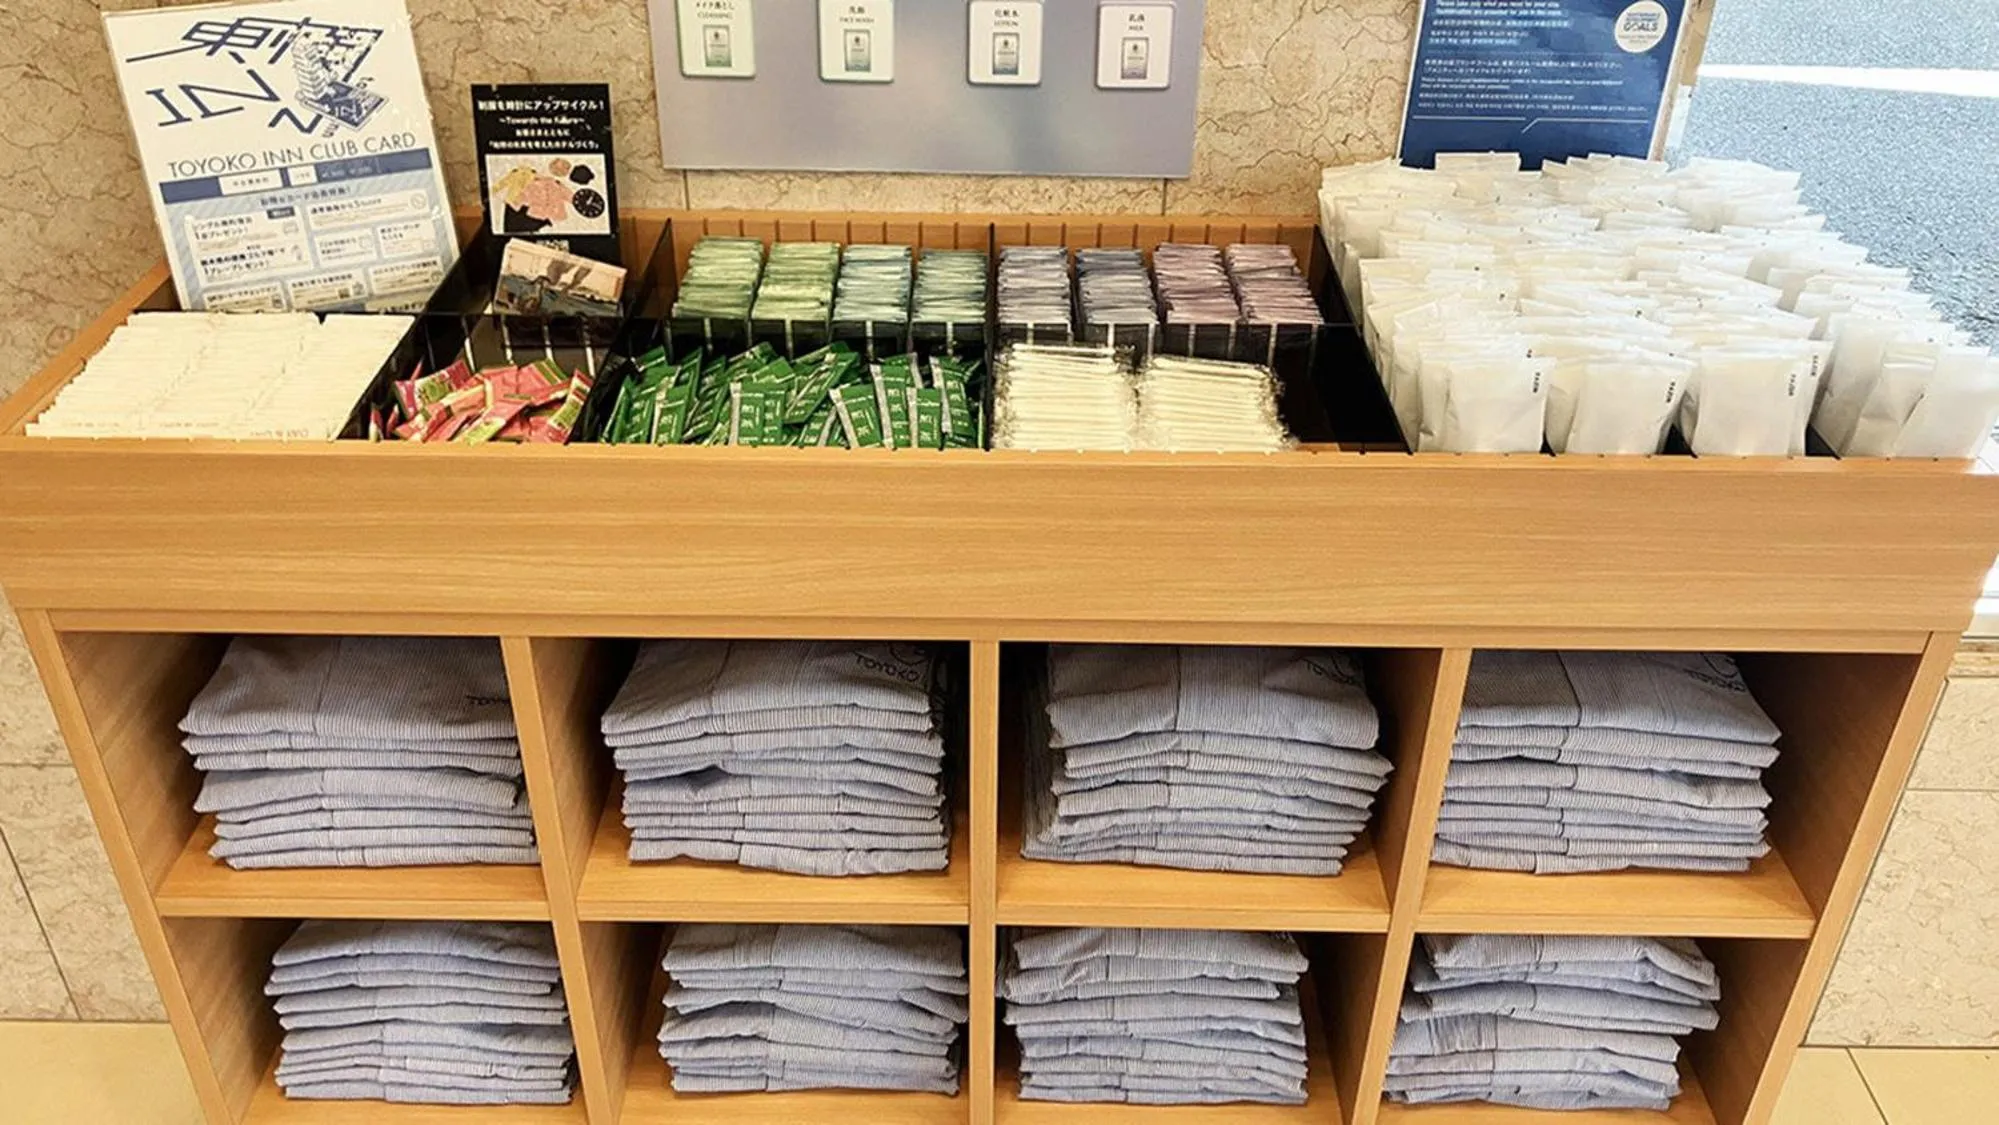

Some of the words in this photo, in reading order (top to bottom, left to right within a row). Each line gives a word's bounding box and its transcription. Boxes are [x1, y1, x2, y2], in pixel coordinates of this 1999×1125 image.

[168, 152, 257, 178] TOYOKO
[263, 147, 304, 166] INN
[310, 141, 359, 161] CLUB
[364, 132, 416, 153] CARD
[853, 648, 920, 682] TOYOKO
